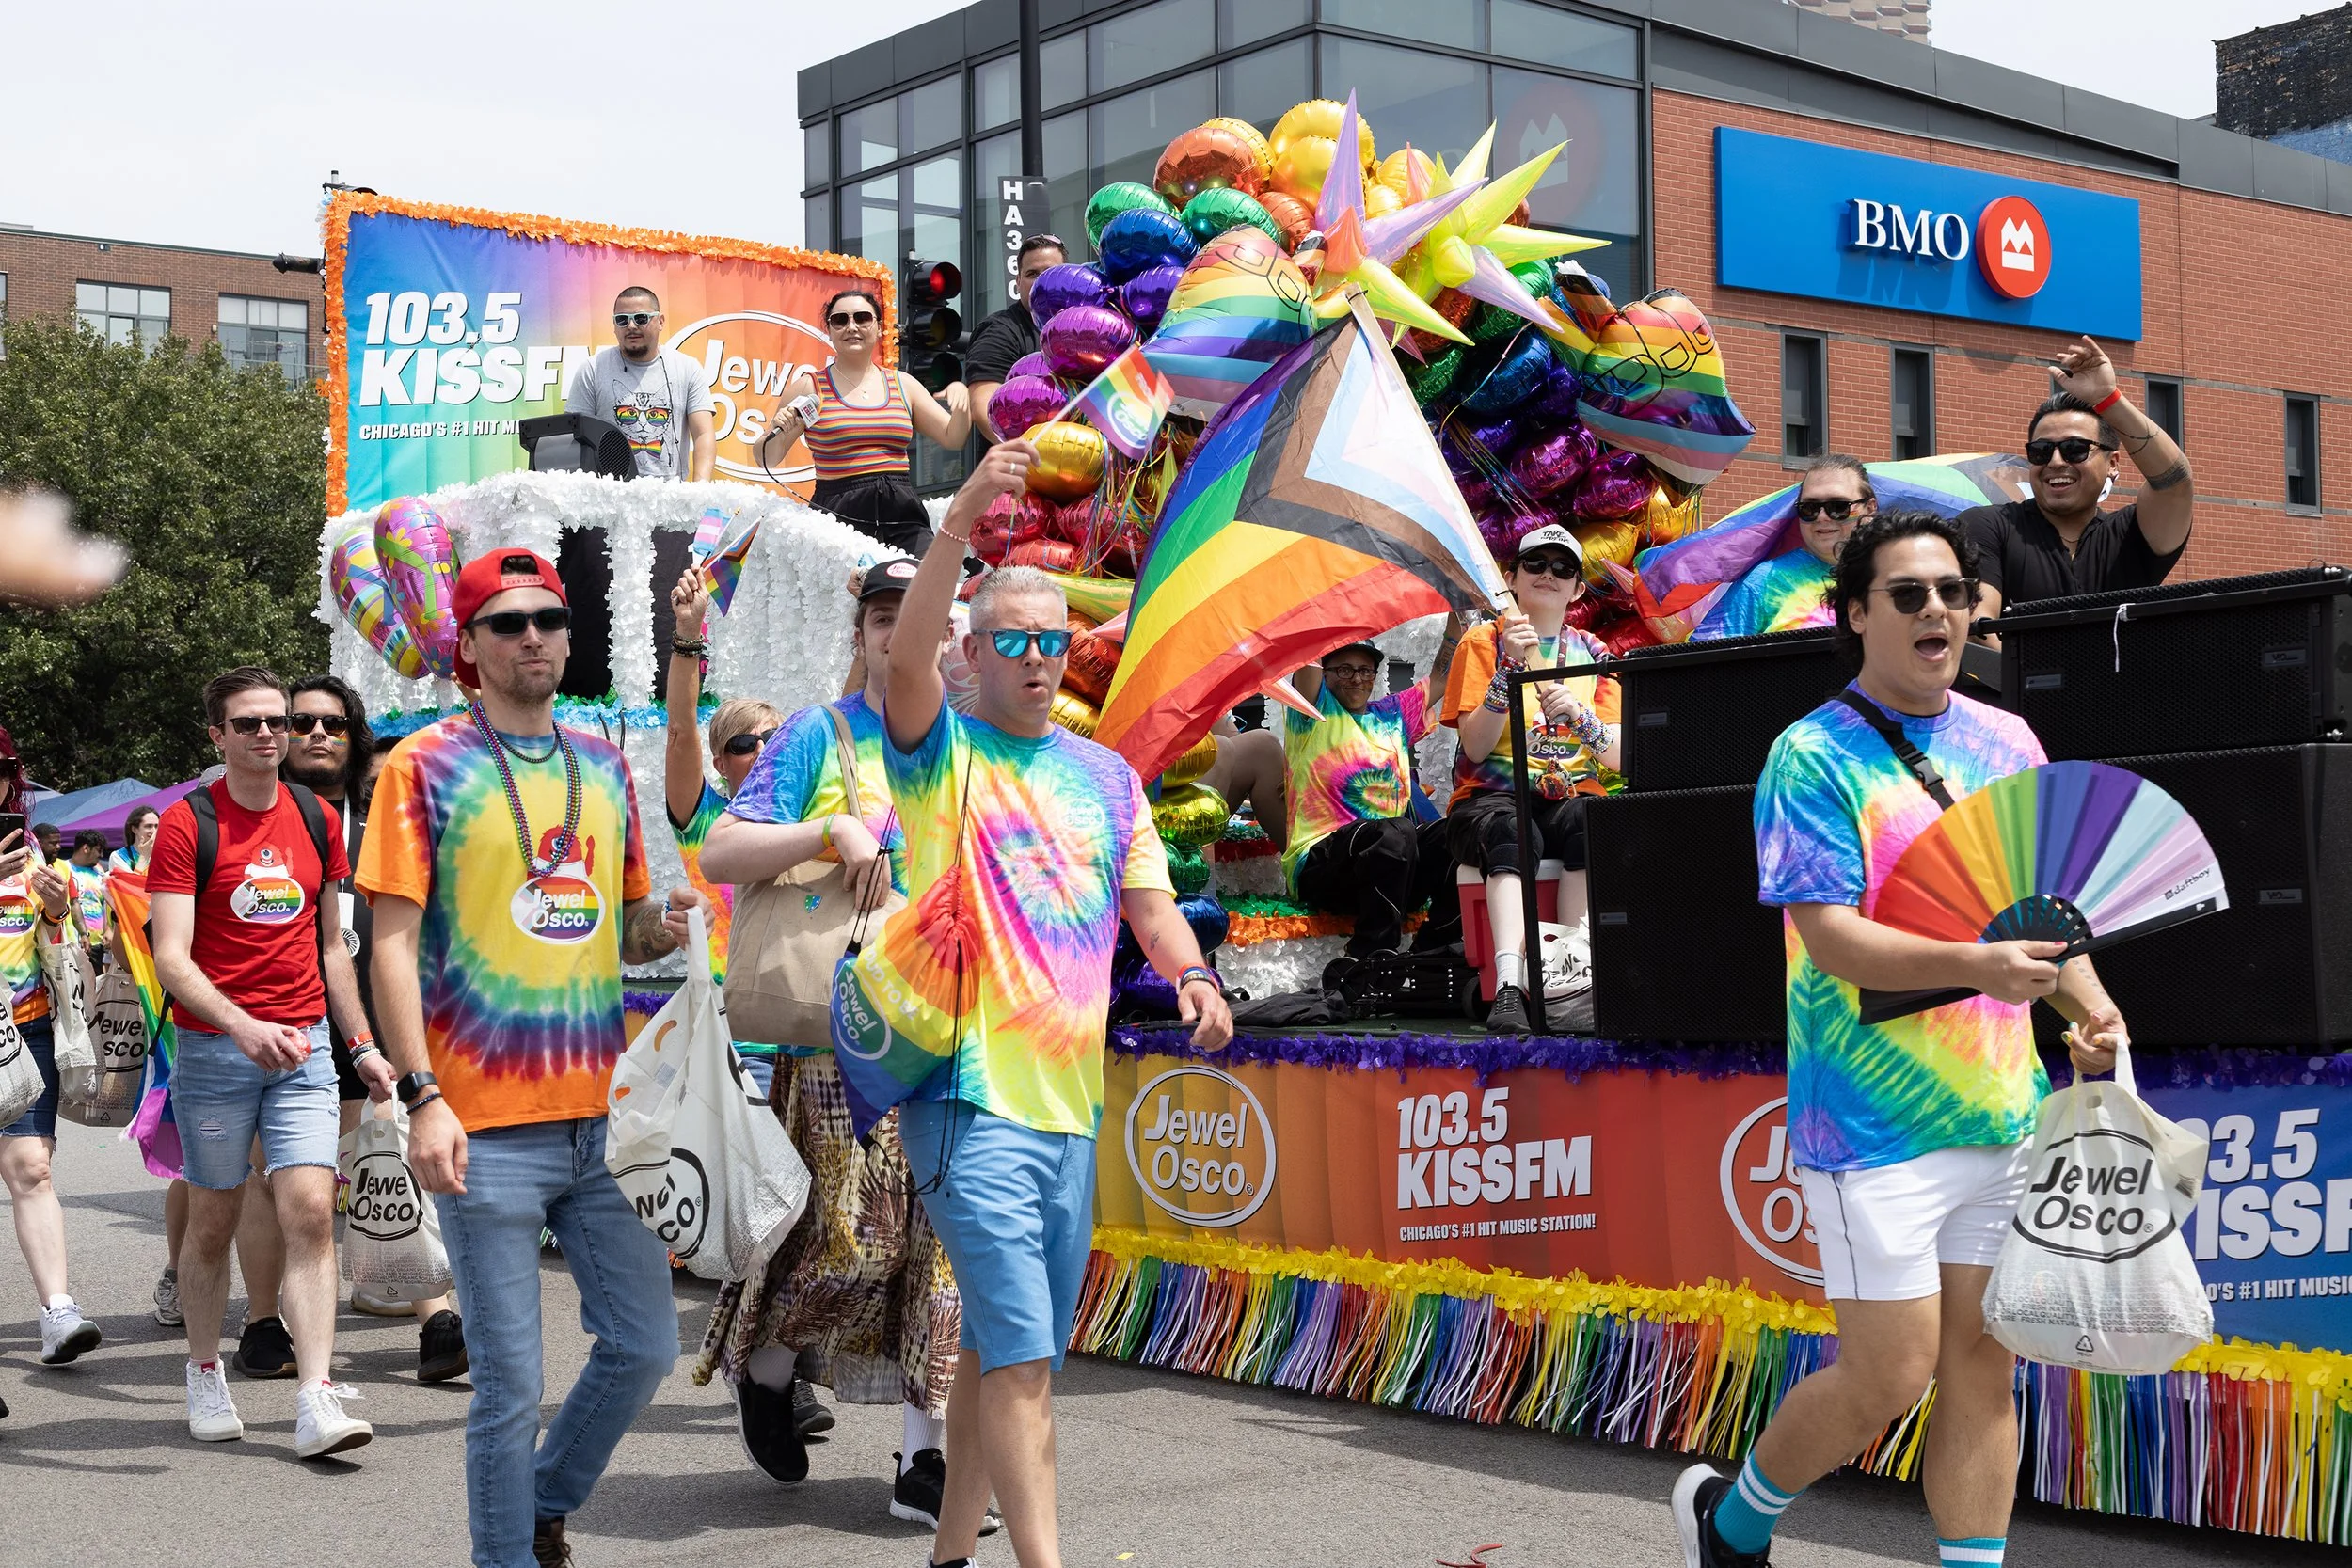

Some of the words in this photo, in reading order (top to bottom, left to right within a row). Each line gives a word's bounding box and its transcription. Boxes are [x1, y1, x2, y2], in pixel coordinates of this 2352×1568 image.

[1853, 198, 1970, 261] BMO
[366, 292, 522, 345] 103.5
[705, 339, 835, 397] Jew
[360, 423, 448, 440] CHICAGO'S
[451, 421, 470, 437] #1
[472, 420, 500, 436] HIT
[247, 885, 290, 901] Jewel
[2174, 867, 2210, 895] daftboy
[246, 901, 288, 914] Osco
[532, 888, 586, 910] Jewel
[532, 909, 586, 928] Osco
[845, 970, 878, 1032] Jewel
[882, 980, 902, 1004] TO
[838, 982, 860, 1040] Osco
[103, 1041, 145, 1058] sco
[1144, 1095, 1249, 1148] Jewel
[1397, 1087, 1509, 1149] 103.5
[1397, 1136, 1592, 1210] KISSFM
[2029, 1156, 2153, 1195] Jewel
[353, 1196, 414, 1222] Osco
[2195, 1179, 2352, 1260] ISSF
[1400, 1224, 1459, 1242] CHICAGO'S
[1461, 1223, 1475, 1238] #1
[1477, 1222, 1497, 1237] HIT
[1499, 1219, 1538, 1235] MUSIC
[1540, 1213, 1597, 1232] STATION!
[2239, 1280, 2261, 1301] #1
[2265, 1279, 2296, 1298] HIT
